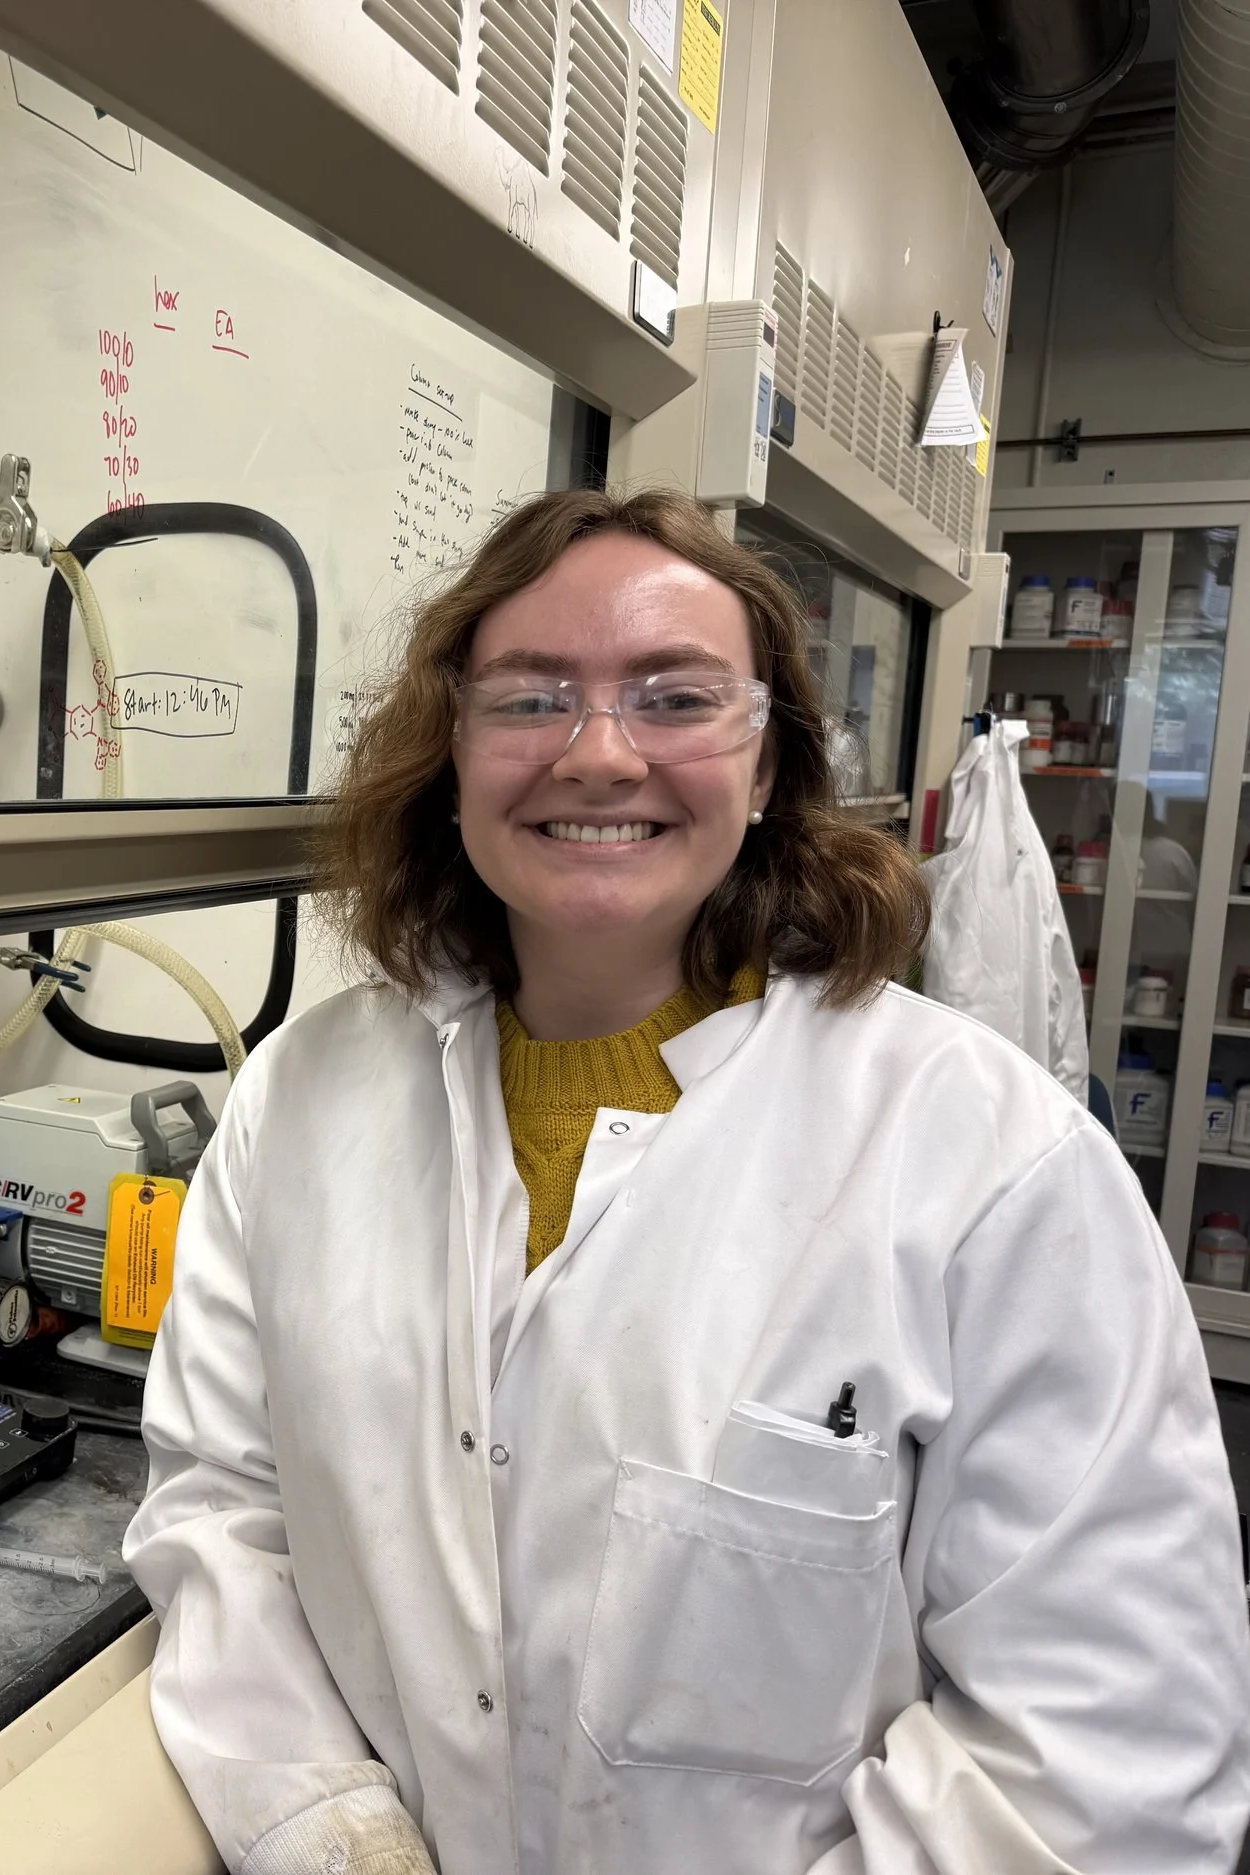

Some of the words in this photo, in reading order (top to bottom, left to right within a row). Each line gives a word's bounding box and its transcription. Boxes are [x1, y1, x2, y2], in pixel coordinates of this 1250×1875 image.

[215, 309, 235, 340] EA
[98, 329, 134, 367] 100/0
[100, 358, 129, 405] 90/10
[102, 405, 137, 448] 80/20
[104, 445, 140, 484] 70/30
